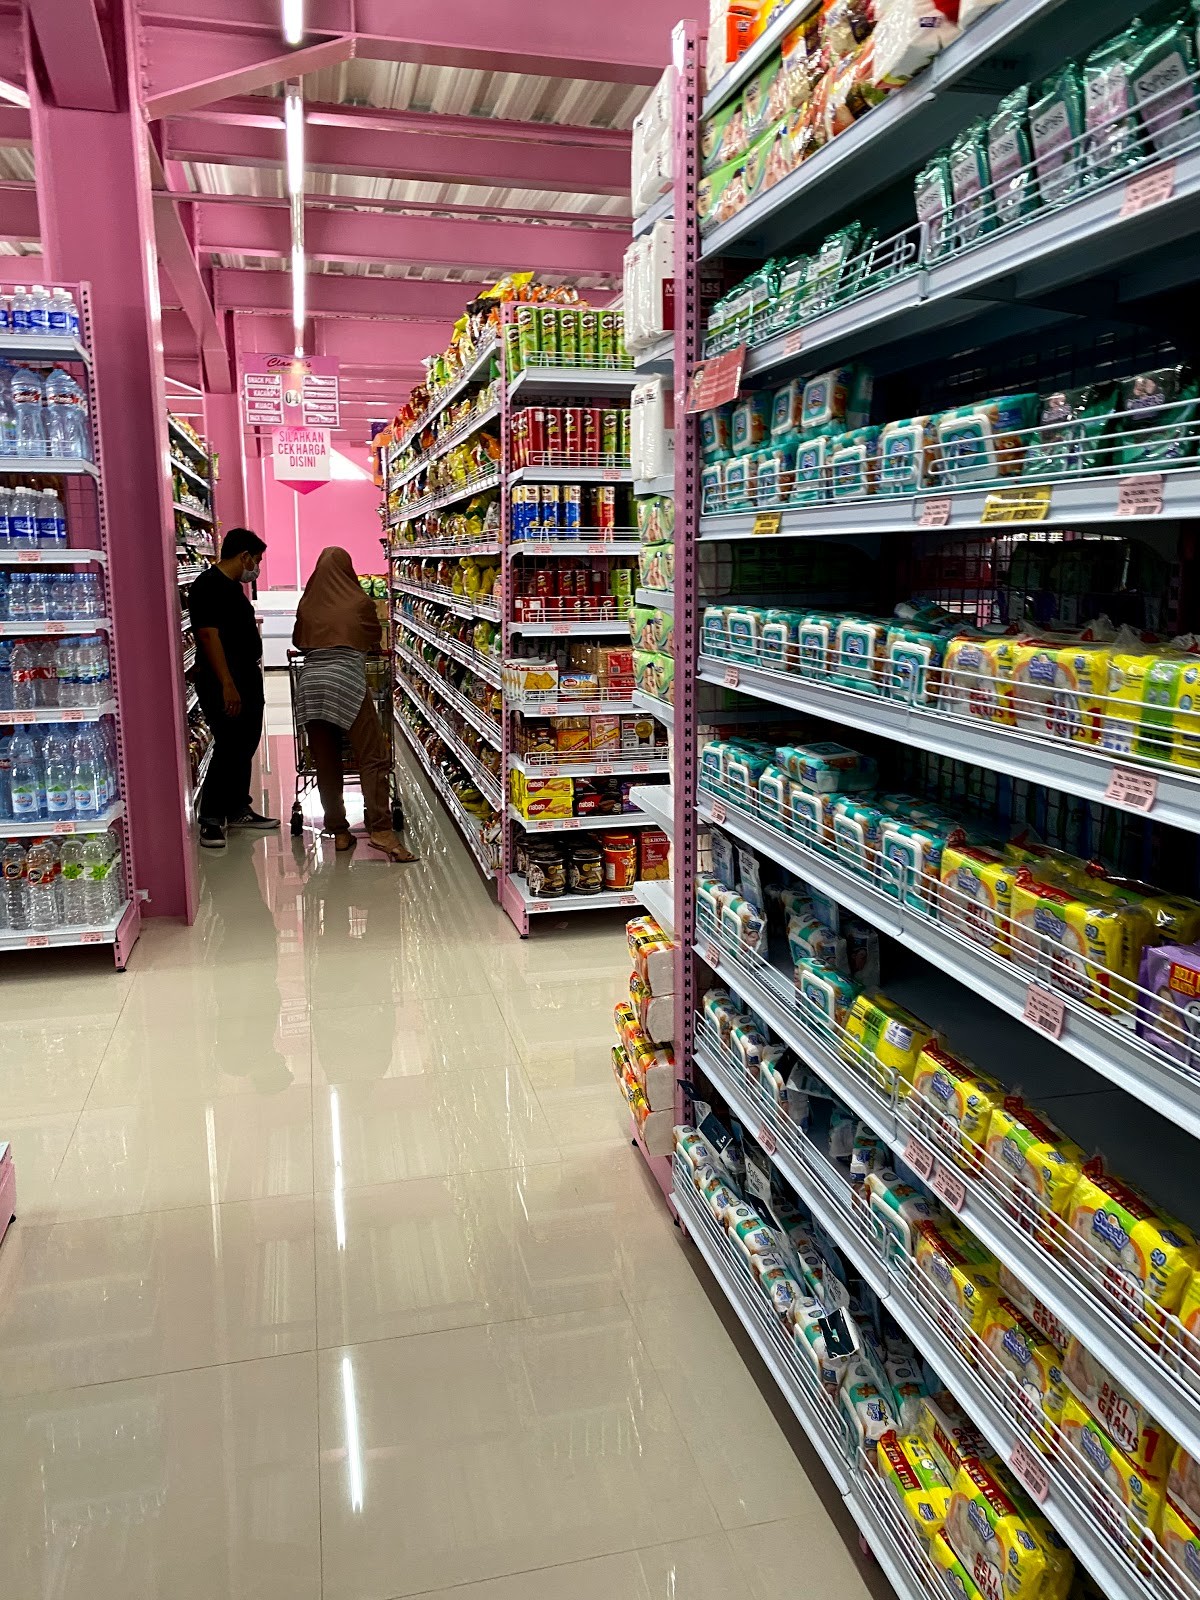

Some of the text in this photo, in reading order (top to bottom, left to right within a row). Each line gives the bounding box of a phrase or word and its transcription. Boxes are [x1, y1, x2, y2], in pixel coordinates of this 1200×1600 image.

[286, 392, 299, 403] 04
[280, 431, 324, 442] SILAHKAN
[278, 444, 326, 456] CEK HARGA
[290, 456, 316, 467] DISINI
[1093, 1209, 1129, 1248] Sweety
[1151, 1250, 1166, 1266] 50
[1102, 1381, 1128, 1419] BELI
[1097, 1396, 1140, 1452] GRATIS
[1142, 1428, 1160, 1462] 1
[1129, 1475, 1142, 1494] 50
[969, 1500, 994, 1539] Sweety
[976, 1552, 997, 1590] BELI
